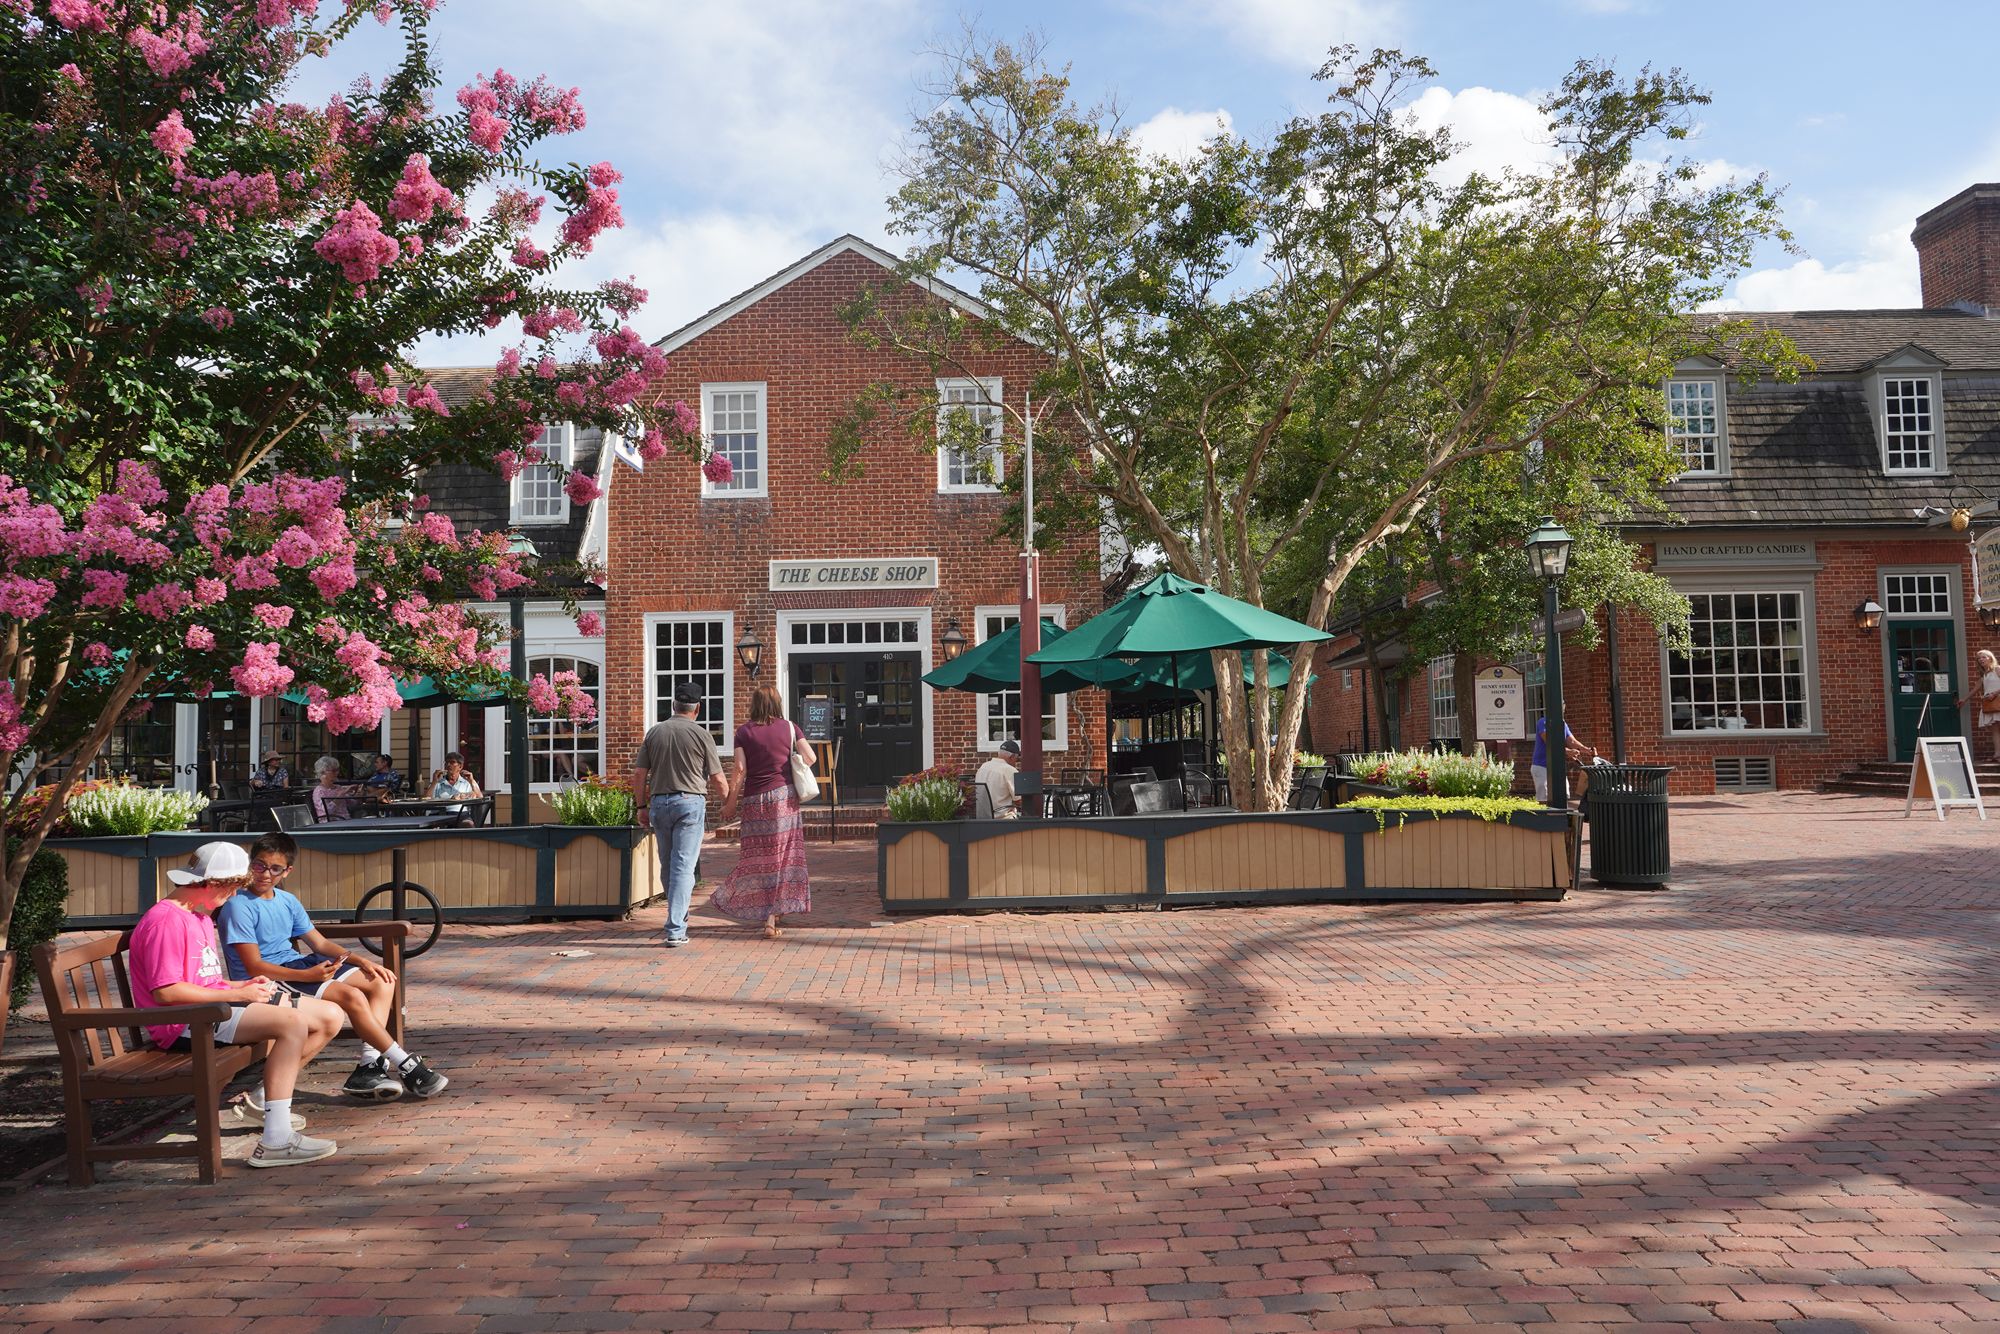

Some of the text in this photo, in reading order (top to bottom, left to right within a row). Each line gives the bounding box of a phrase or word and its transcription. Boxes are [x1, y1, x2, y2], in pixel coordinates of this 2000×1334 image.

[1663, 544, 1806, 556] HAND CRAFTED CANDIES
[779, 566, 928, 583] THE CHEESE SHOP
